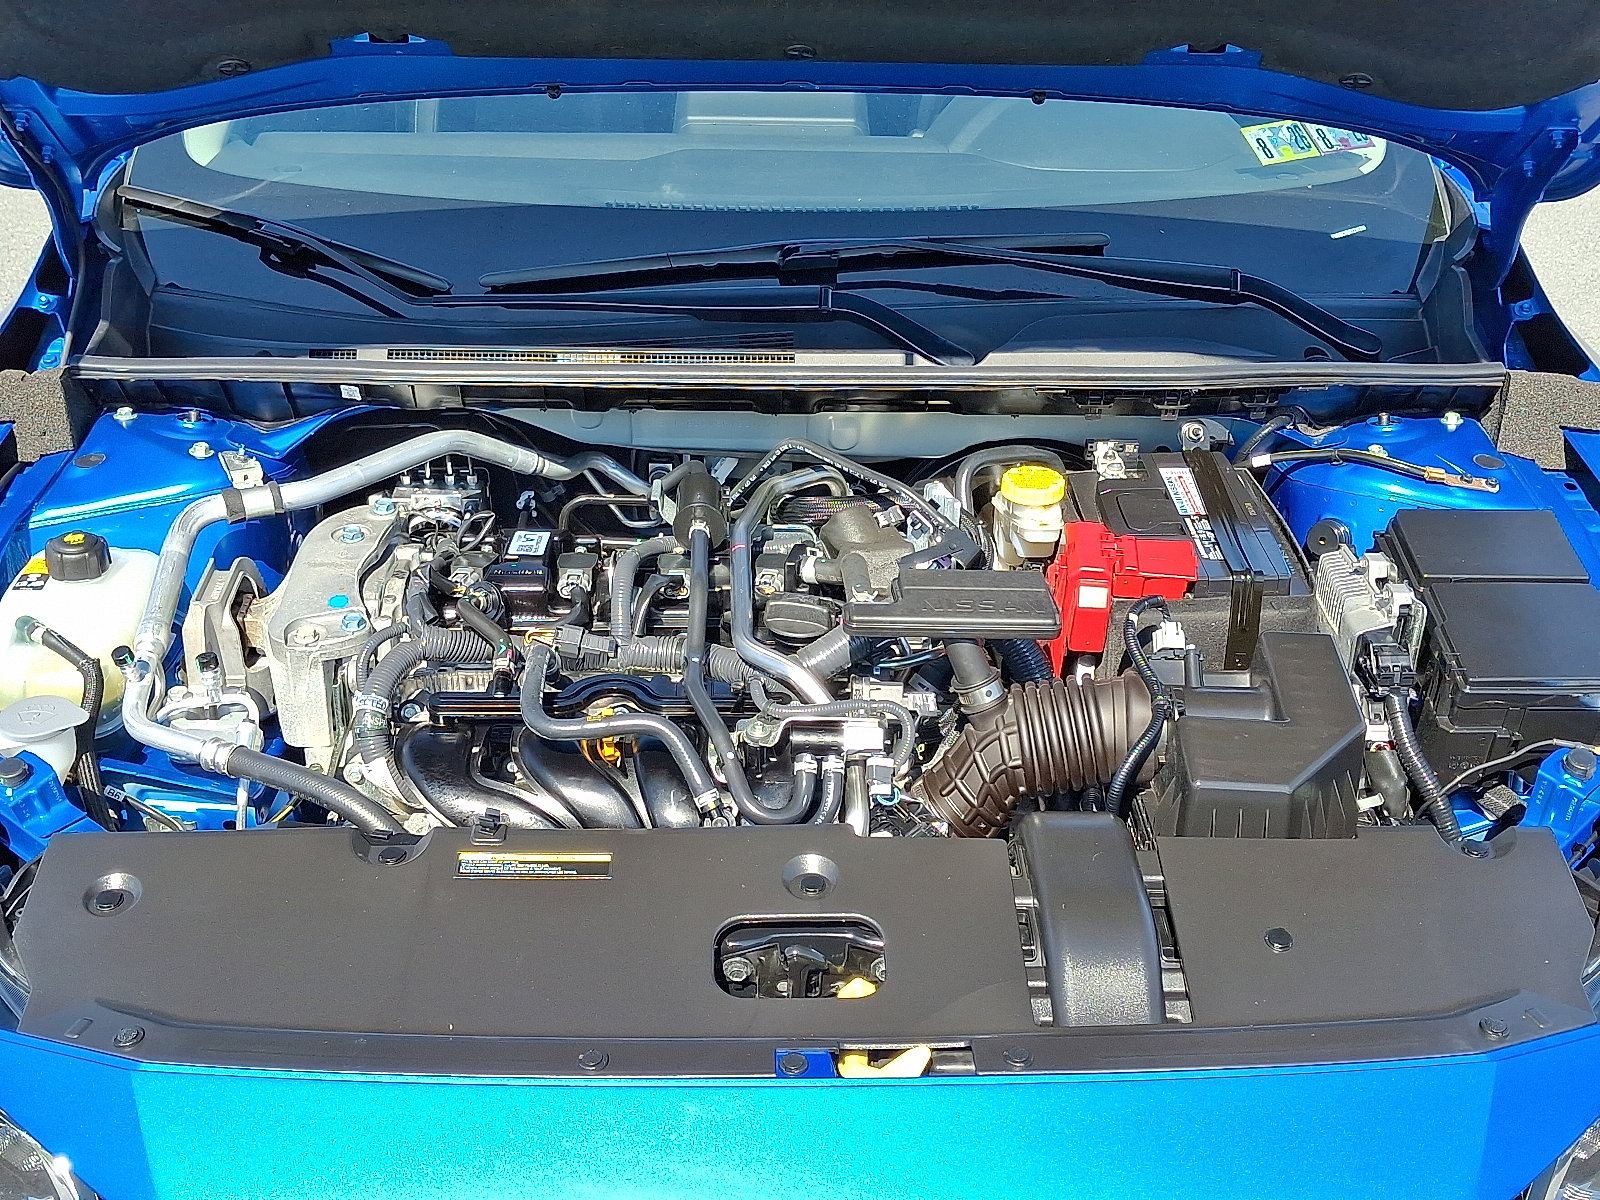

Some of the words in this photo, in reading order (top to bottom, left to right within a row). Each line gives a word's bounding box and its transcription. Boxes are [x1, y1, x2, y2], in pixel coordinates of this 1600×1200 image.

[1256, 138, 1275, 159] 8
[1286, 123, 1312, 150] 26
[1316, 128, 1334, 149] 8
[921, 599, 1046, 613] NISSAN
